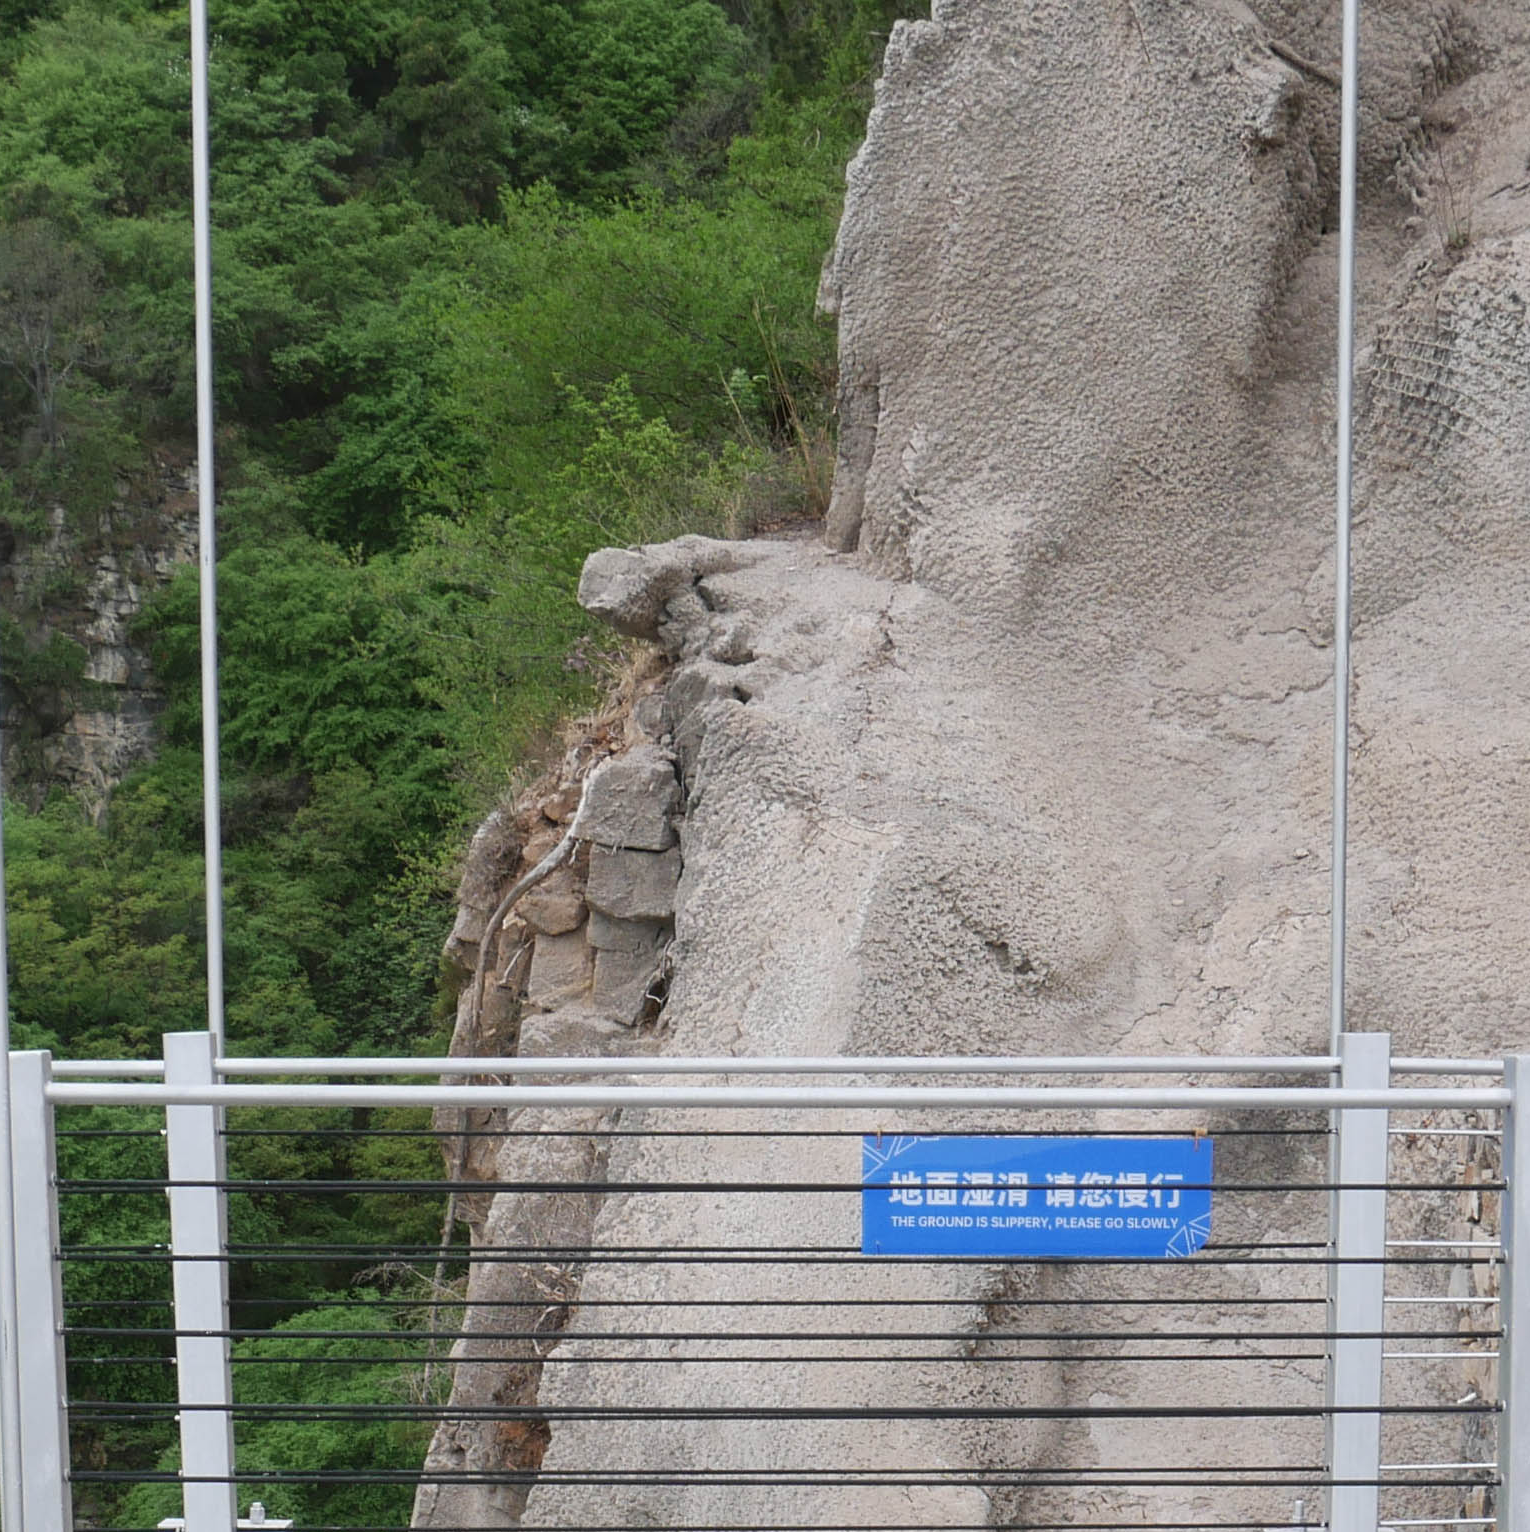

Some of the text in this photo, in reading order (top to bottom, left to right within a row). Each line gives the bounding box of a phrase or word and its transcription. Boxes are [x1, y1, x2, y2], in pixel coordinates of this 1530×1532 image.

[889, 1171, 1183, 1209] 地面湿滑 请您慢行
[891, 1216, 1179, 1230] THE GROUND IS SLIPPERY, PLEASE GO SLOWLY
